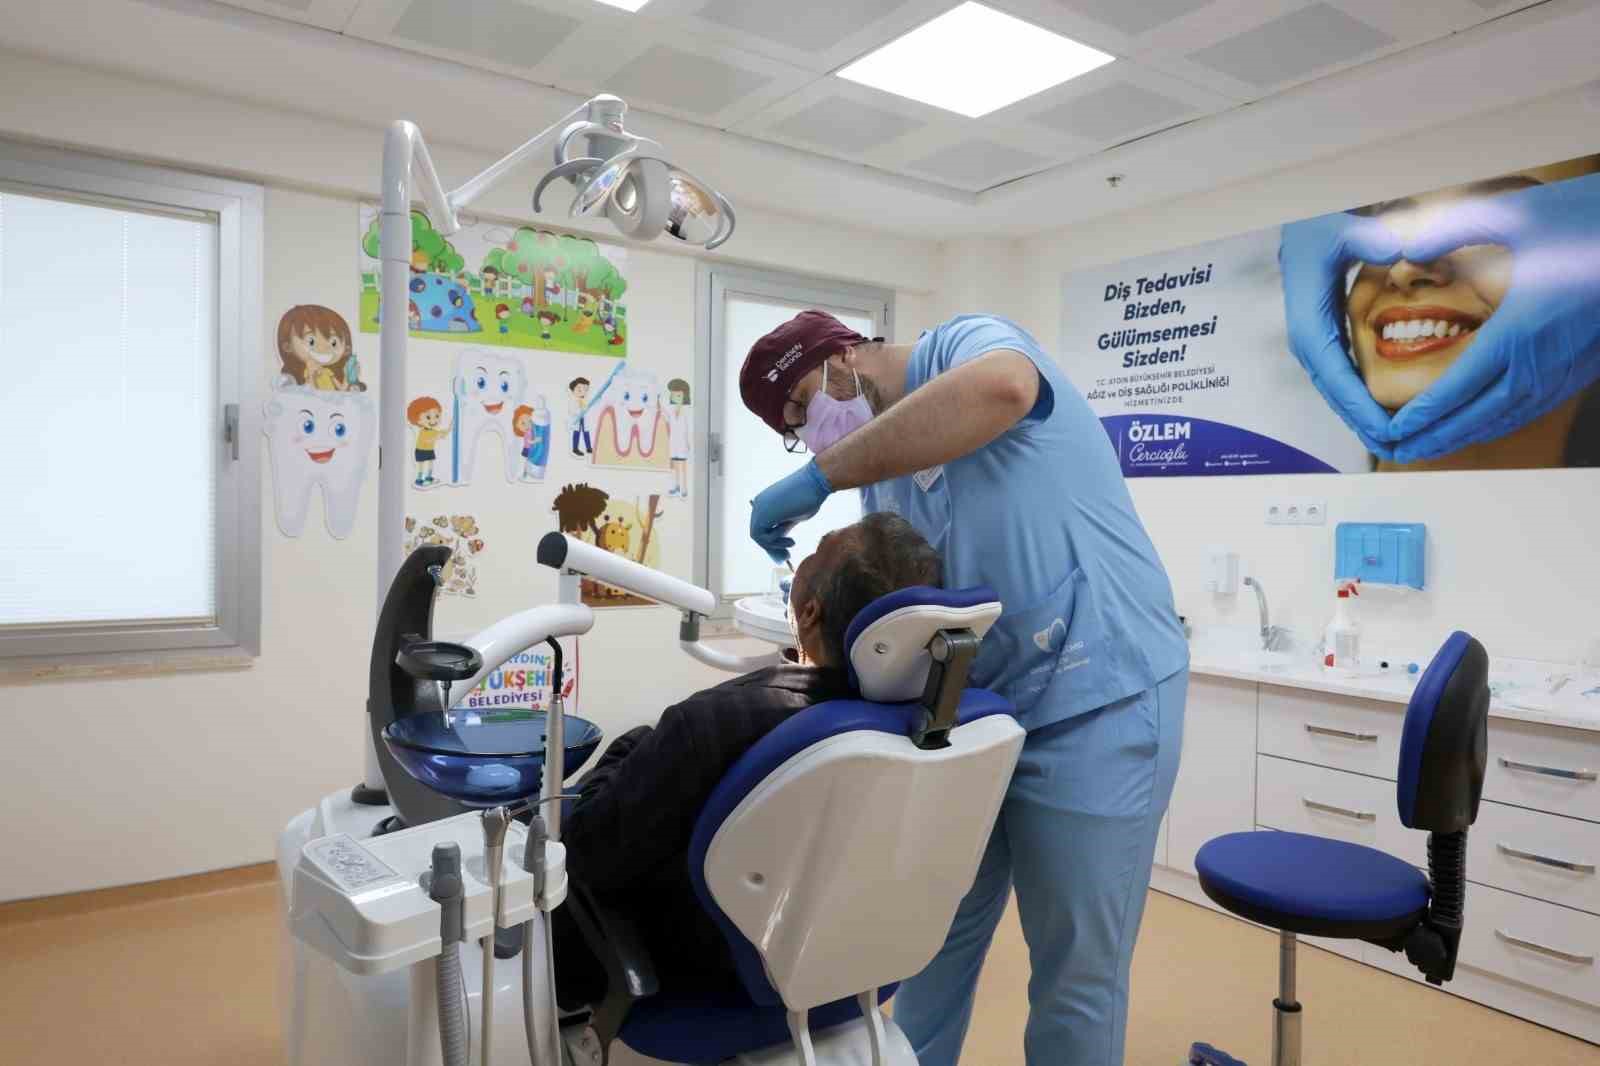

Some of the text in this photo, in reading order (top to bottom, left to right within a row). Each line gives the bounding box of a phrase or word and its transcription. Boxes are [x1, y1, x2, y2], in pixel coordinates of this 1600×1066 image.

[1104, 263, 1212, 302] Diş Tedavisi
[1123, 298, 1186, 320] Bizden,
[1098, 315, 1217, 350] Gülümsemesi
[1123, 344, 1186, 368] Sizden!
[1087, 389, 1107, 400] AĞIZ
[1118, 387, 1133, 398] DİŞ
[1134, 383, 1170, 395] SAĞLIĞI
[1172, 375, 1230, 393] POLİKLİNİĞİ
[1128, 420, 1191, 442] ÖZLEM
[509, 654, 546, 666] YDIN
[469, 690, 543, 708] BELEDİYESİ
